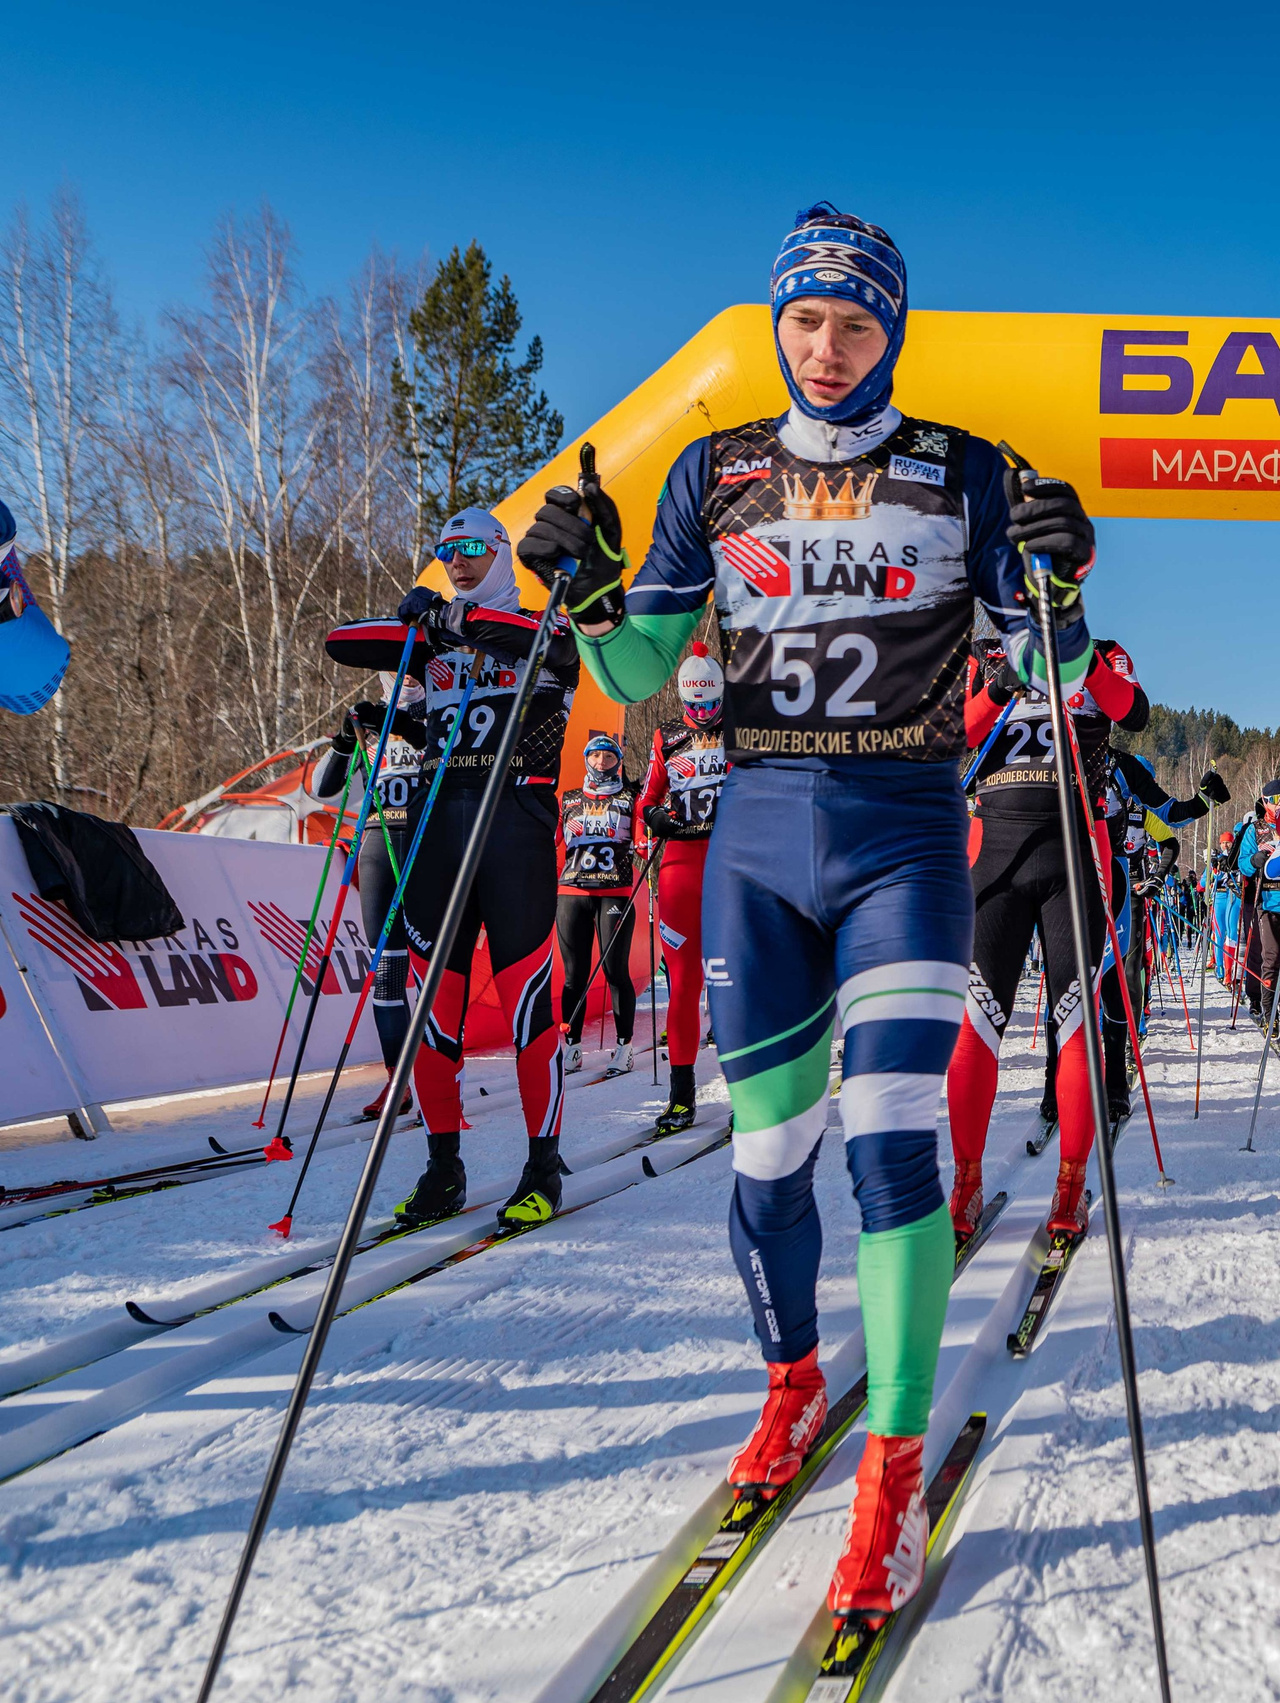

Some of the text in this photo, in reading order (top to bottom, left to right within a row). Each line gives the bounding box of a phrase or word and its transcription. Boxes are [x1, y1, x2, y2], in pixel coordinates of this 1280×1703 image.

[803, 539, 919, 567] KRAS
[803, 562, 917, 599] LAND
[682, 680, 716, 688] LUKOIL
[770, 632, 879, 718] 52
[437, 704, 496, 750] 39
[735, 725, 925, 754] КОРОЛЕВСКИЕ КРАСКИ
[1005, 722, 1056, 765] 29
[390, 755, 424, 767] LAN
[481, 755, 523, 768] КРКИ
[986, 769, 1049, 787] КОРОЛЕВСКИЕ
[679, 788, 722, 822] 13
[586, 827, 616, 839] LAND
[139, 953, 259, 1007] LAND
[749, 1248, 773, 1306] VICTORY
